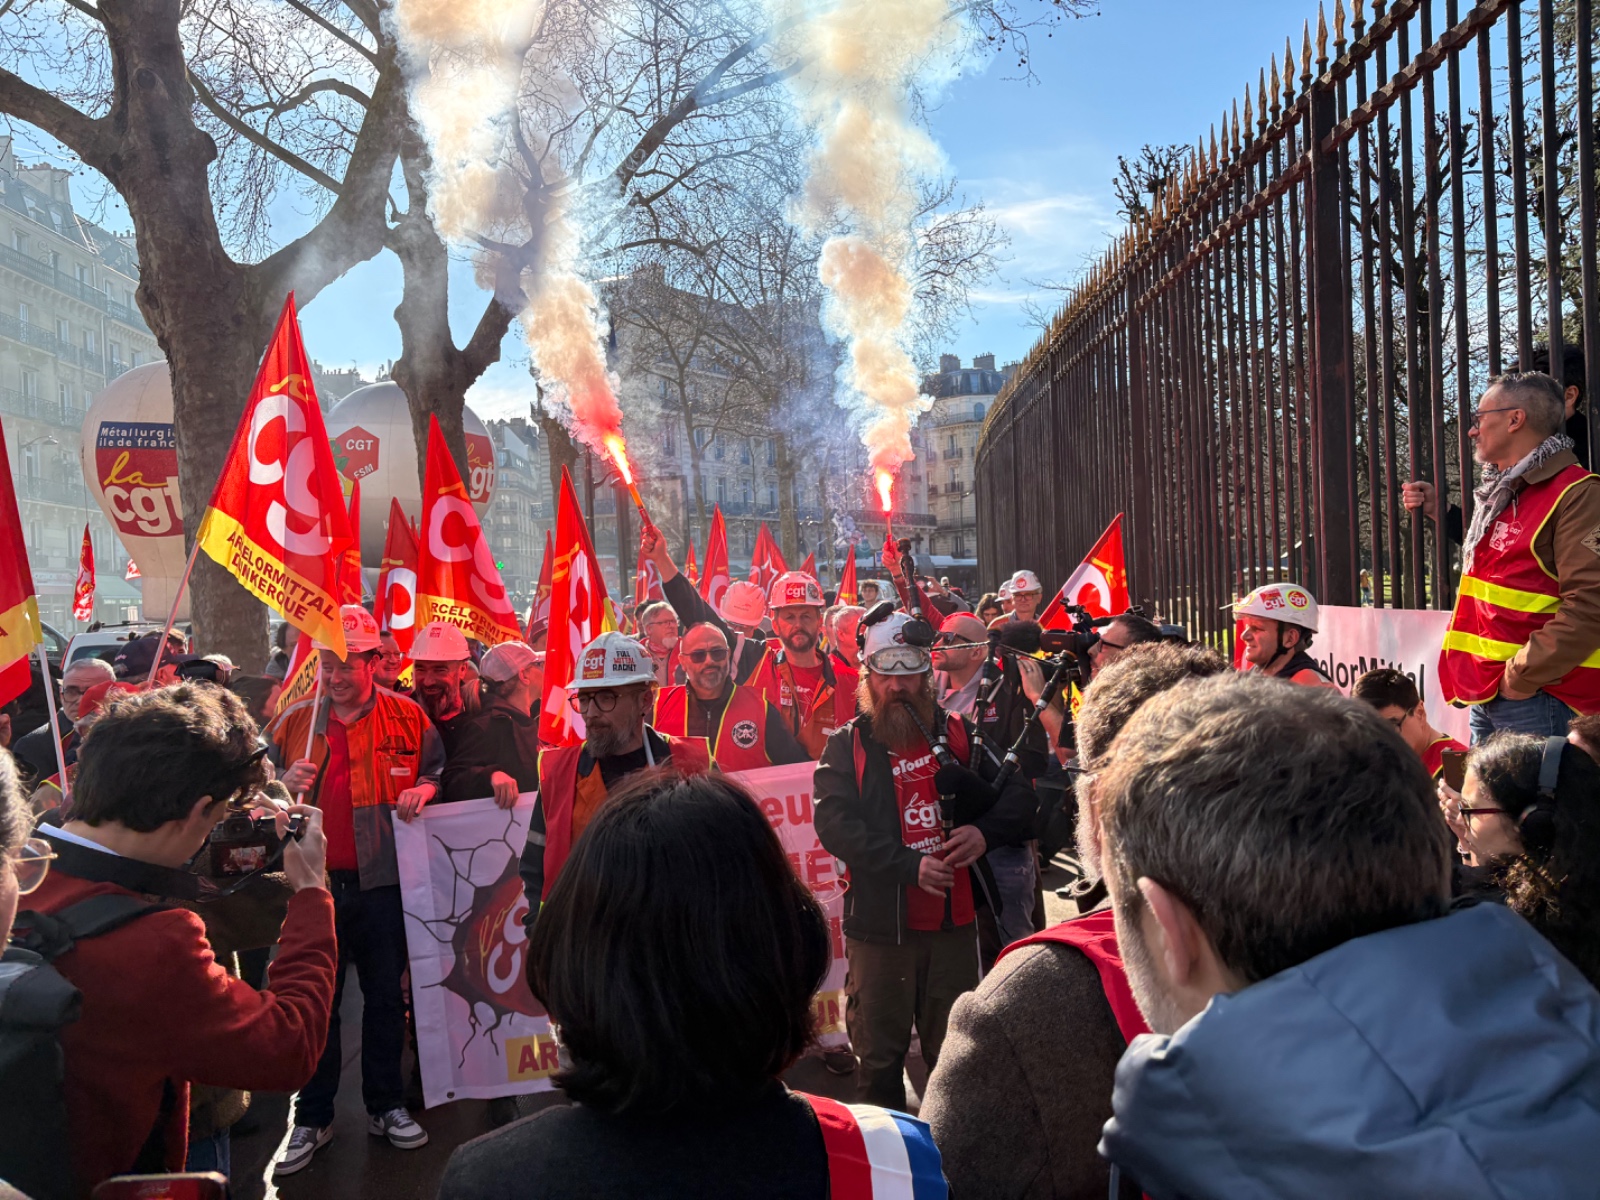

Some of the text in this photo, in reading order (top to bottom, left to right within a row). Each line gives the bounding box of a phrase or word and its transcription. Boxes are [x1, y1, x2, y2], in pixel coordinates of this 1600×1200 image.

[117, 438, 132, 447] de
[138, 438, 175, 448] franc
[346, 439, 374, 451] CGT
[103, 451, 168, 487] la
[468, 461, 495, 499] gt
[227, 530, 334, 621] ARELORMITTAL
[787, 587, 805, 597] cgt
[1290, 596, 1306, 606] cgt
[585, 654, 606, 670] cgt
[906, 836, 941, 850] ontre
